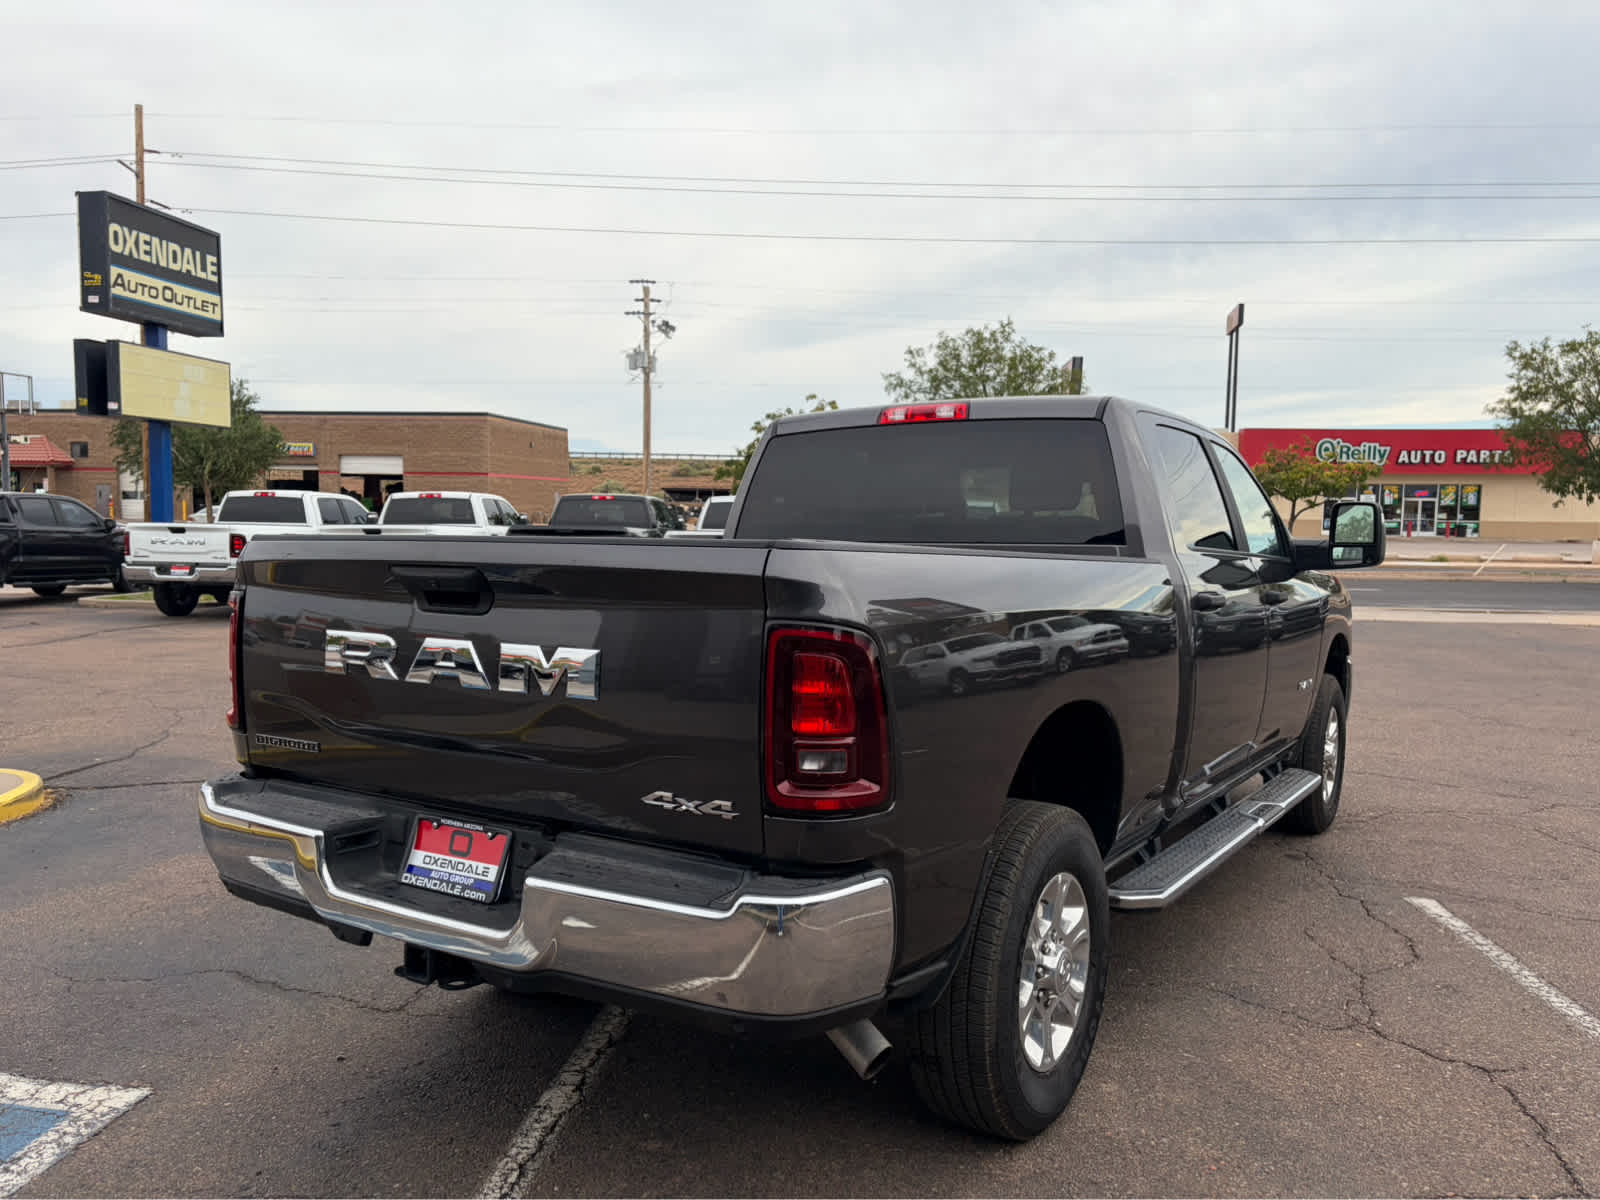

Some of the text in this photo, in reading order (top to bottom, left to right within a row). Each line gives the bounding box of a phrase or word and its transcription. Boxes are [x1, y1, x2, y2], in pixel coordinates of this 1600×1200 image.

[108, 222, 218, 283] OXENDALE
[111, 272, 160, 300] AUTO
[161, 285, 219, 315] OUTLET
[1315, 438, 1391, 466] O'Reilly
[1397, 450, 1447, 465] AUTO
[325, 628, 601, 701] RAM
[422, 854, 491, 878] OXENDALE
[430, 870, 475, 885] AUTO GROUP
